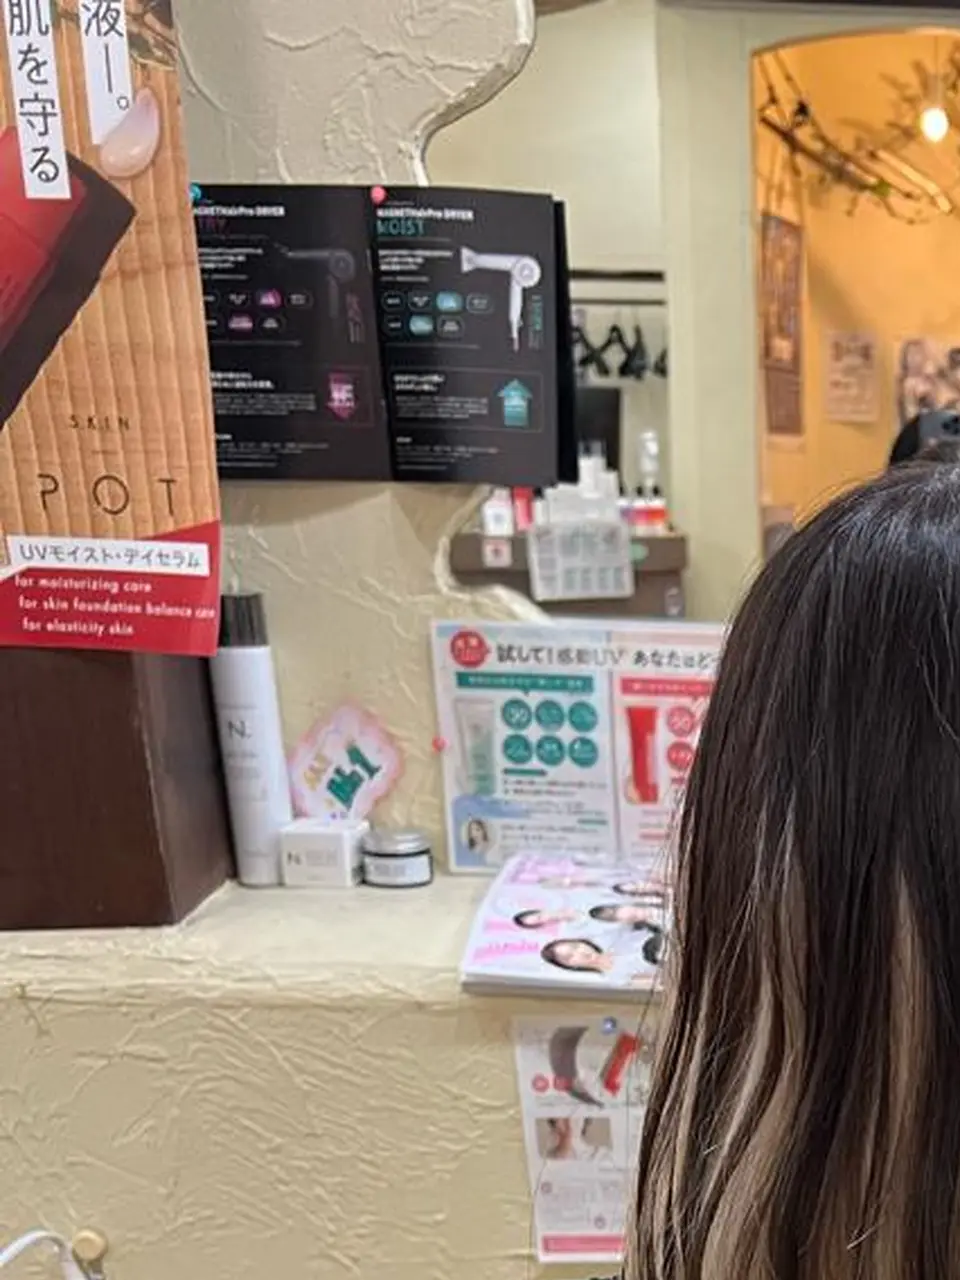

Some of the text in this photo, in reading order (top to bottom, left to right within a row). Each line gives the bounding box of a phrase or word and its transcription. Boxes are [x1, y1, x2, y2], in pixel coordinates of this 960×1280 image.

[9, 0, 60, 184] 肌を守る
[376, 219, 425, 236] MOIST
[68, 414, 130, 431] SKIN
[37, 473, 177, 517] POT
[15, 575, 152, 593] for moisturizing care
[18, 595, 38, 609] for
[43, 596, 69, 610] skin
[73, 597, 142, 614] foundation
[146, 602, 193, 618] balance
[22, 617, 134, 637] for elasticity skin
